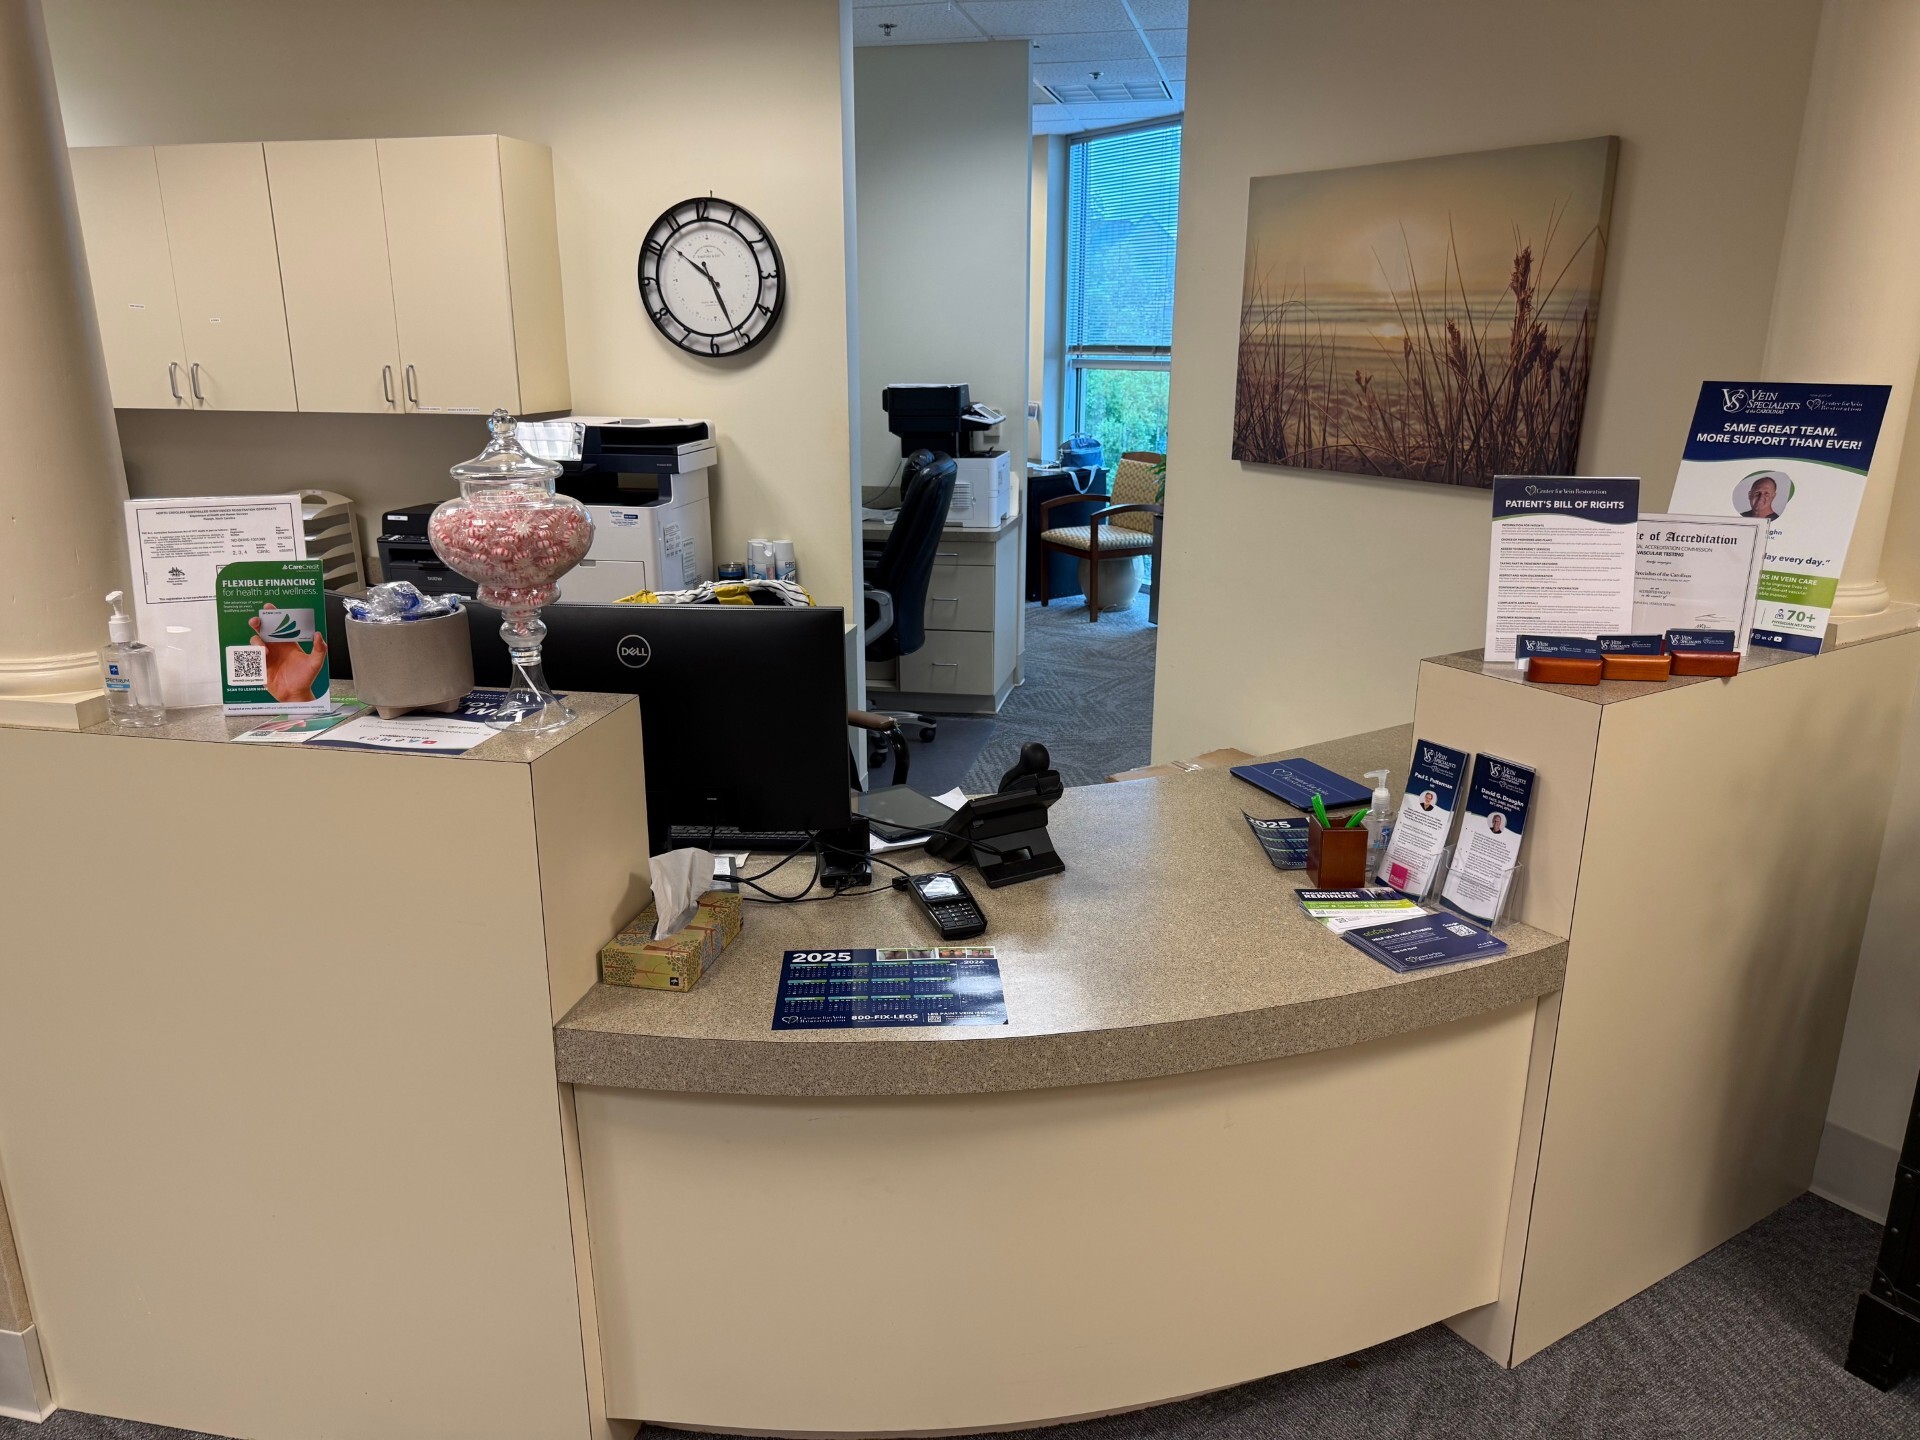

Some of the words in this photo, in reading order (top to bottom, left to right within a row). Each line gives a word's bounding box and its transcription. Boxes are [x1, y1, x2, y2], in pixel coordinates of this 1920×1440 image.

[695, 200, 709, 220] 12
[748, 231, 765, 250] 2
[645, 238, 663, 256] 10
[760, 269, 778, 279] 3
[642, 277, 658, 287] 9
[654, 307, 669, 322] 8
[757, 302, 772, 316] 4
[1751, 389, 1778, 400] VEIN
[1747, 399, 1801, 410] SPECIALISTS
[1723, 422, 1756, 432] SAME
[1759, 424, 1798, 435] GREAT
[1800, 426, 1838, 436] TEAM.
[1696, 433, 1730, 443] MORE
[1732, 435, 1788, 446] SUPPORT
[1789, 437, 1823, 448] THAN
[1826, 439, 1862, 450] EVER!
[1505, 500, 1552, 508] PATIENT'S
[1554, 500, 1572, 508] BILL
[1590, 501, 1624, 509] RIGHTS
[1650, 532, 1661, 541] of
[1665, 531, 1738, 545] Accreditation
[1779, 556, 1804, 565] every
[222, 579, 263, 588] FLEXIBLE
[265, 579, 316, 587] FINANCING
[1798, 578, 1818, 586] CARE
[222, 588, 234, 596] for
[236, 588, 262, 596] health
[264, 587, 280, 595] and
[282, 587, 319, 595] wellness.
[1787, 609, 1816, 622] 70+
[621, 646, 648, 656] DELL
[1414, 771, 1425, 780] Paul
[1481, 787, 1496, 797] David
[1248, 817, 1292, 829] 2025
[792, 952, 852, 962] 2025
